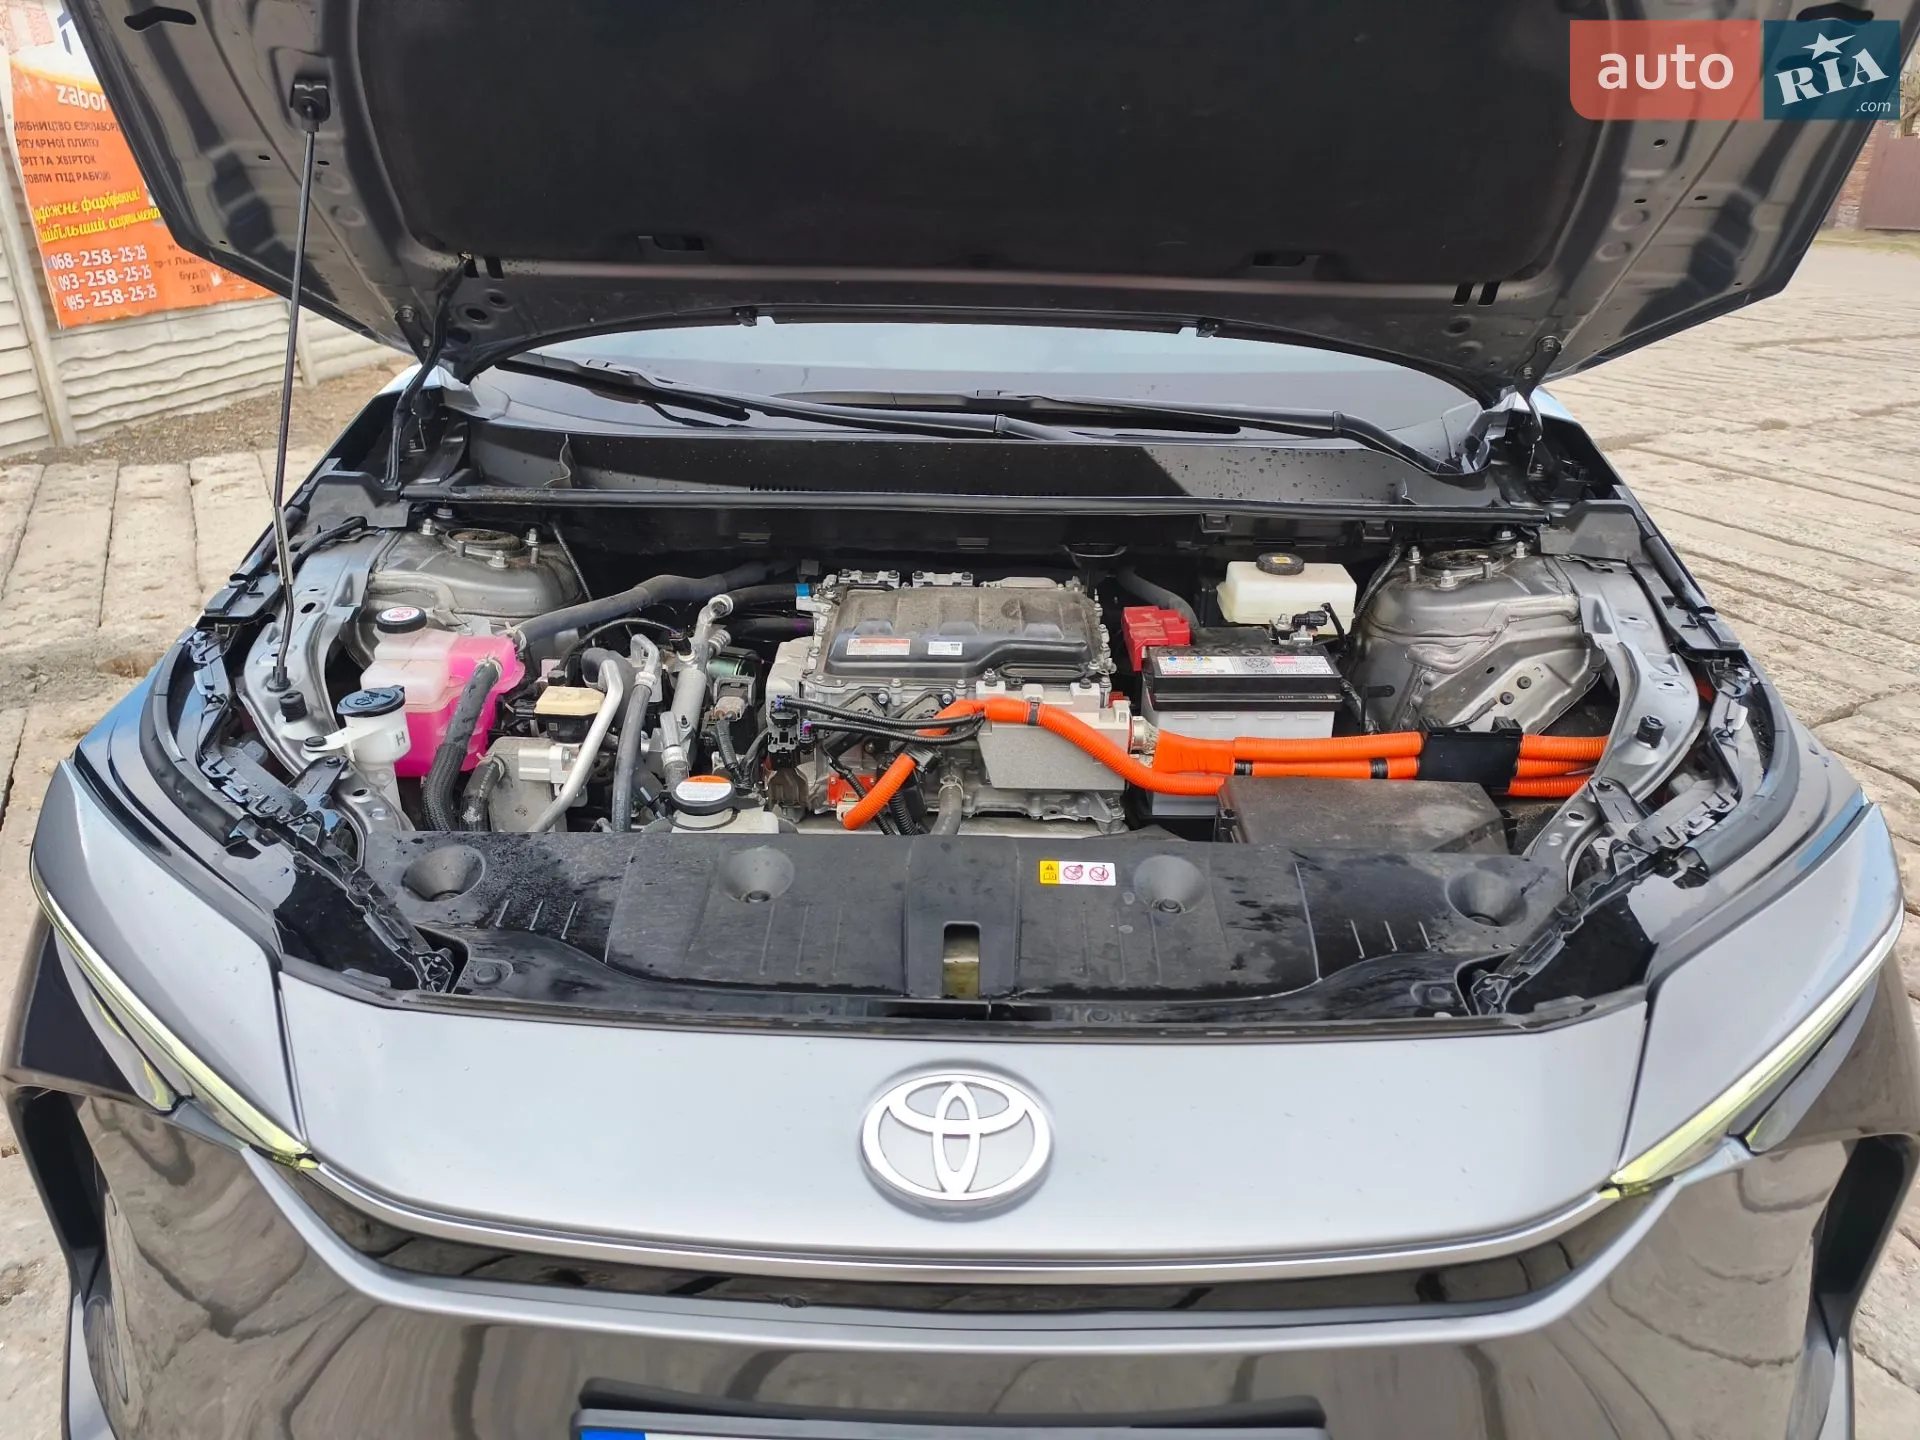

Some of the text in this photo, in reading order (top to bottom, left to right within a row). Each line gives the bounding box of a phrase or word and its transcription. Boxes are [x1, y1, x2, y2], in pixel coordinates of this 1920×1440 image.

[55, 172, 76, 184] ПІД
[51, 244, 148, 270] 068-258-25-25
[58, 264, 153, 291] 093-258-25-25
